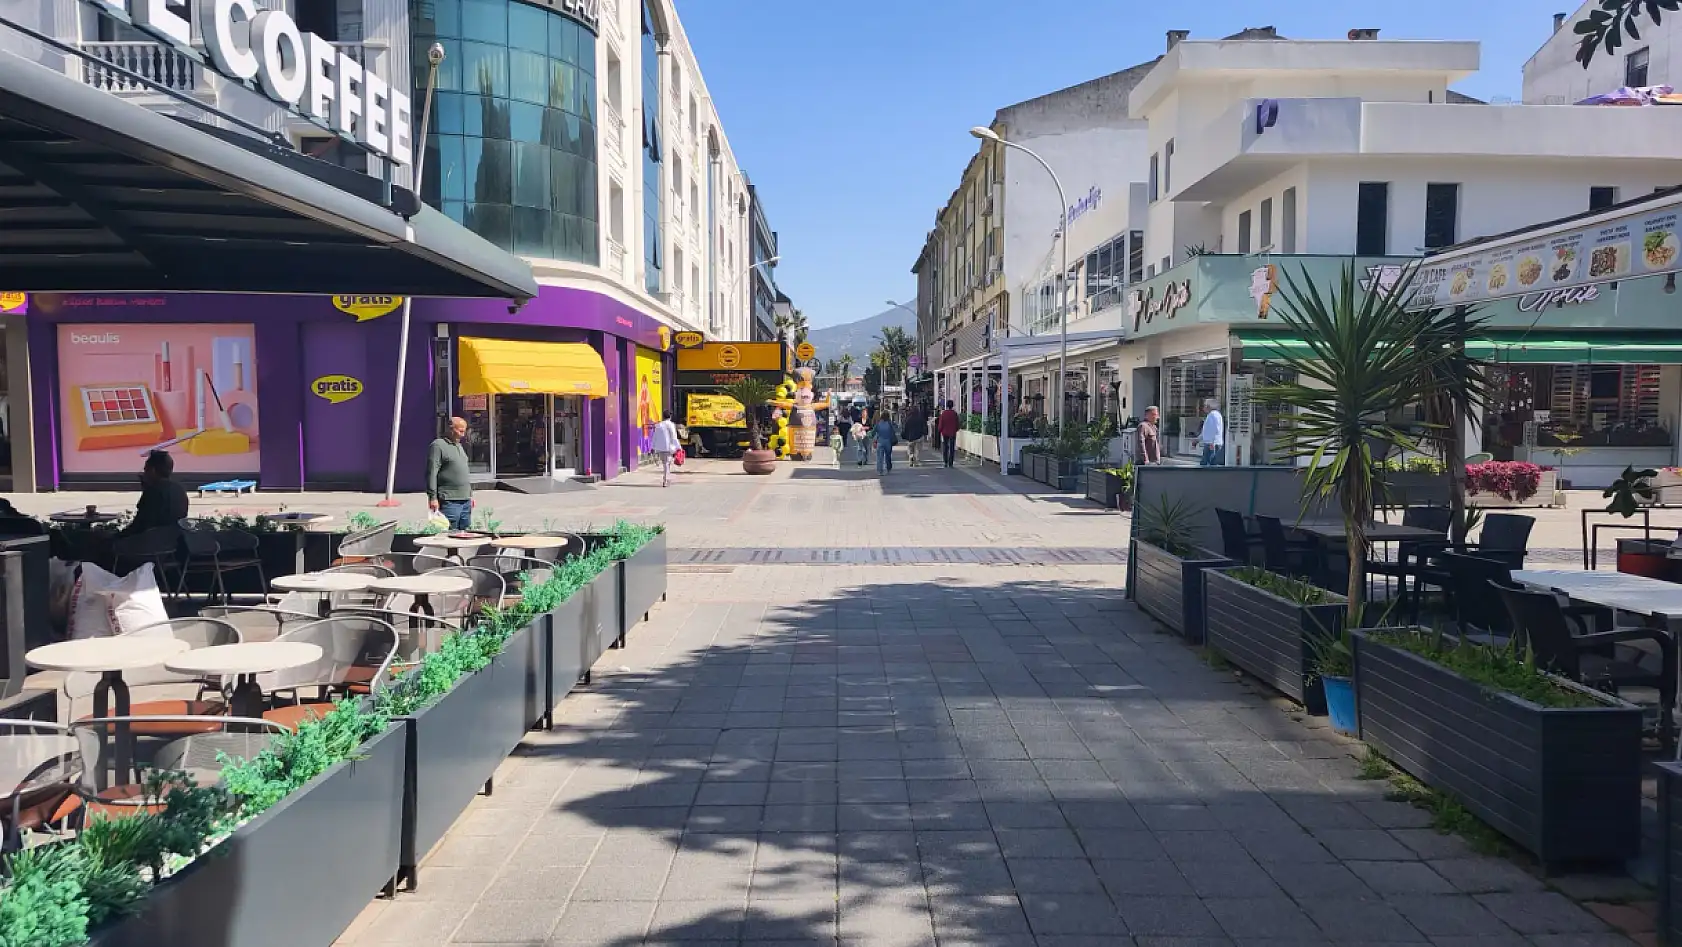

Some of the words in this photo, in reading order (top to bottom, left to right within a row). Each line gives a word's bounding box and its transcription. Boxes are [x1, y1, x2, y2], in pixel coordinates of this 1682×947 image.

[201, 0, 412, 166] COFFEE
[70, 332, 121, 344] beaulis
[316, 379, 359, 394] gratis
